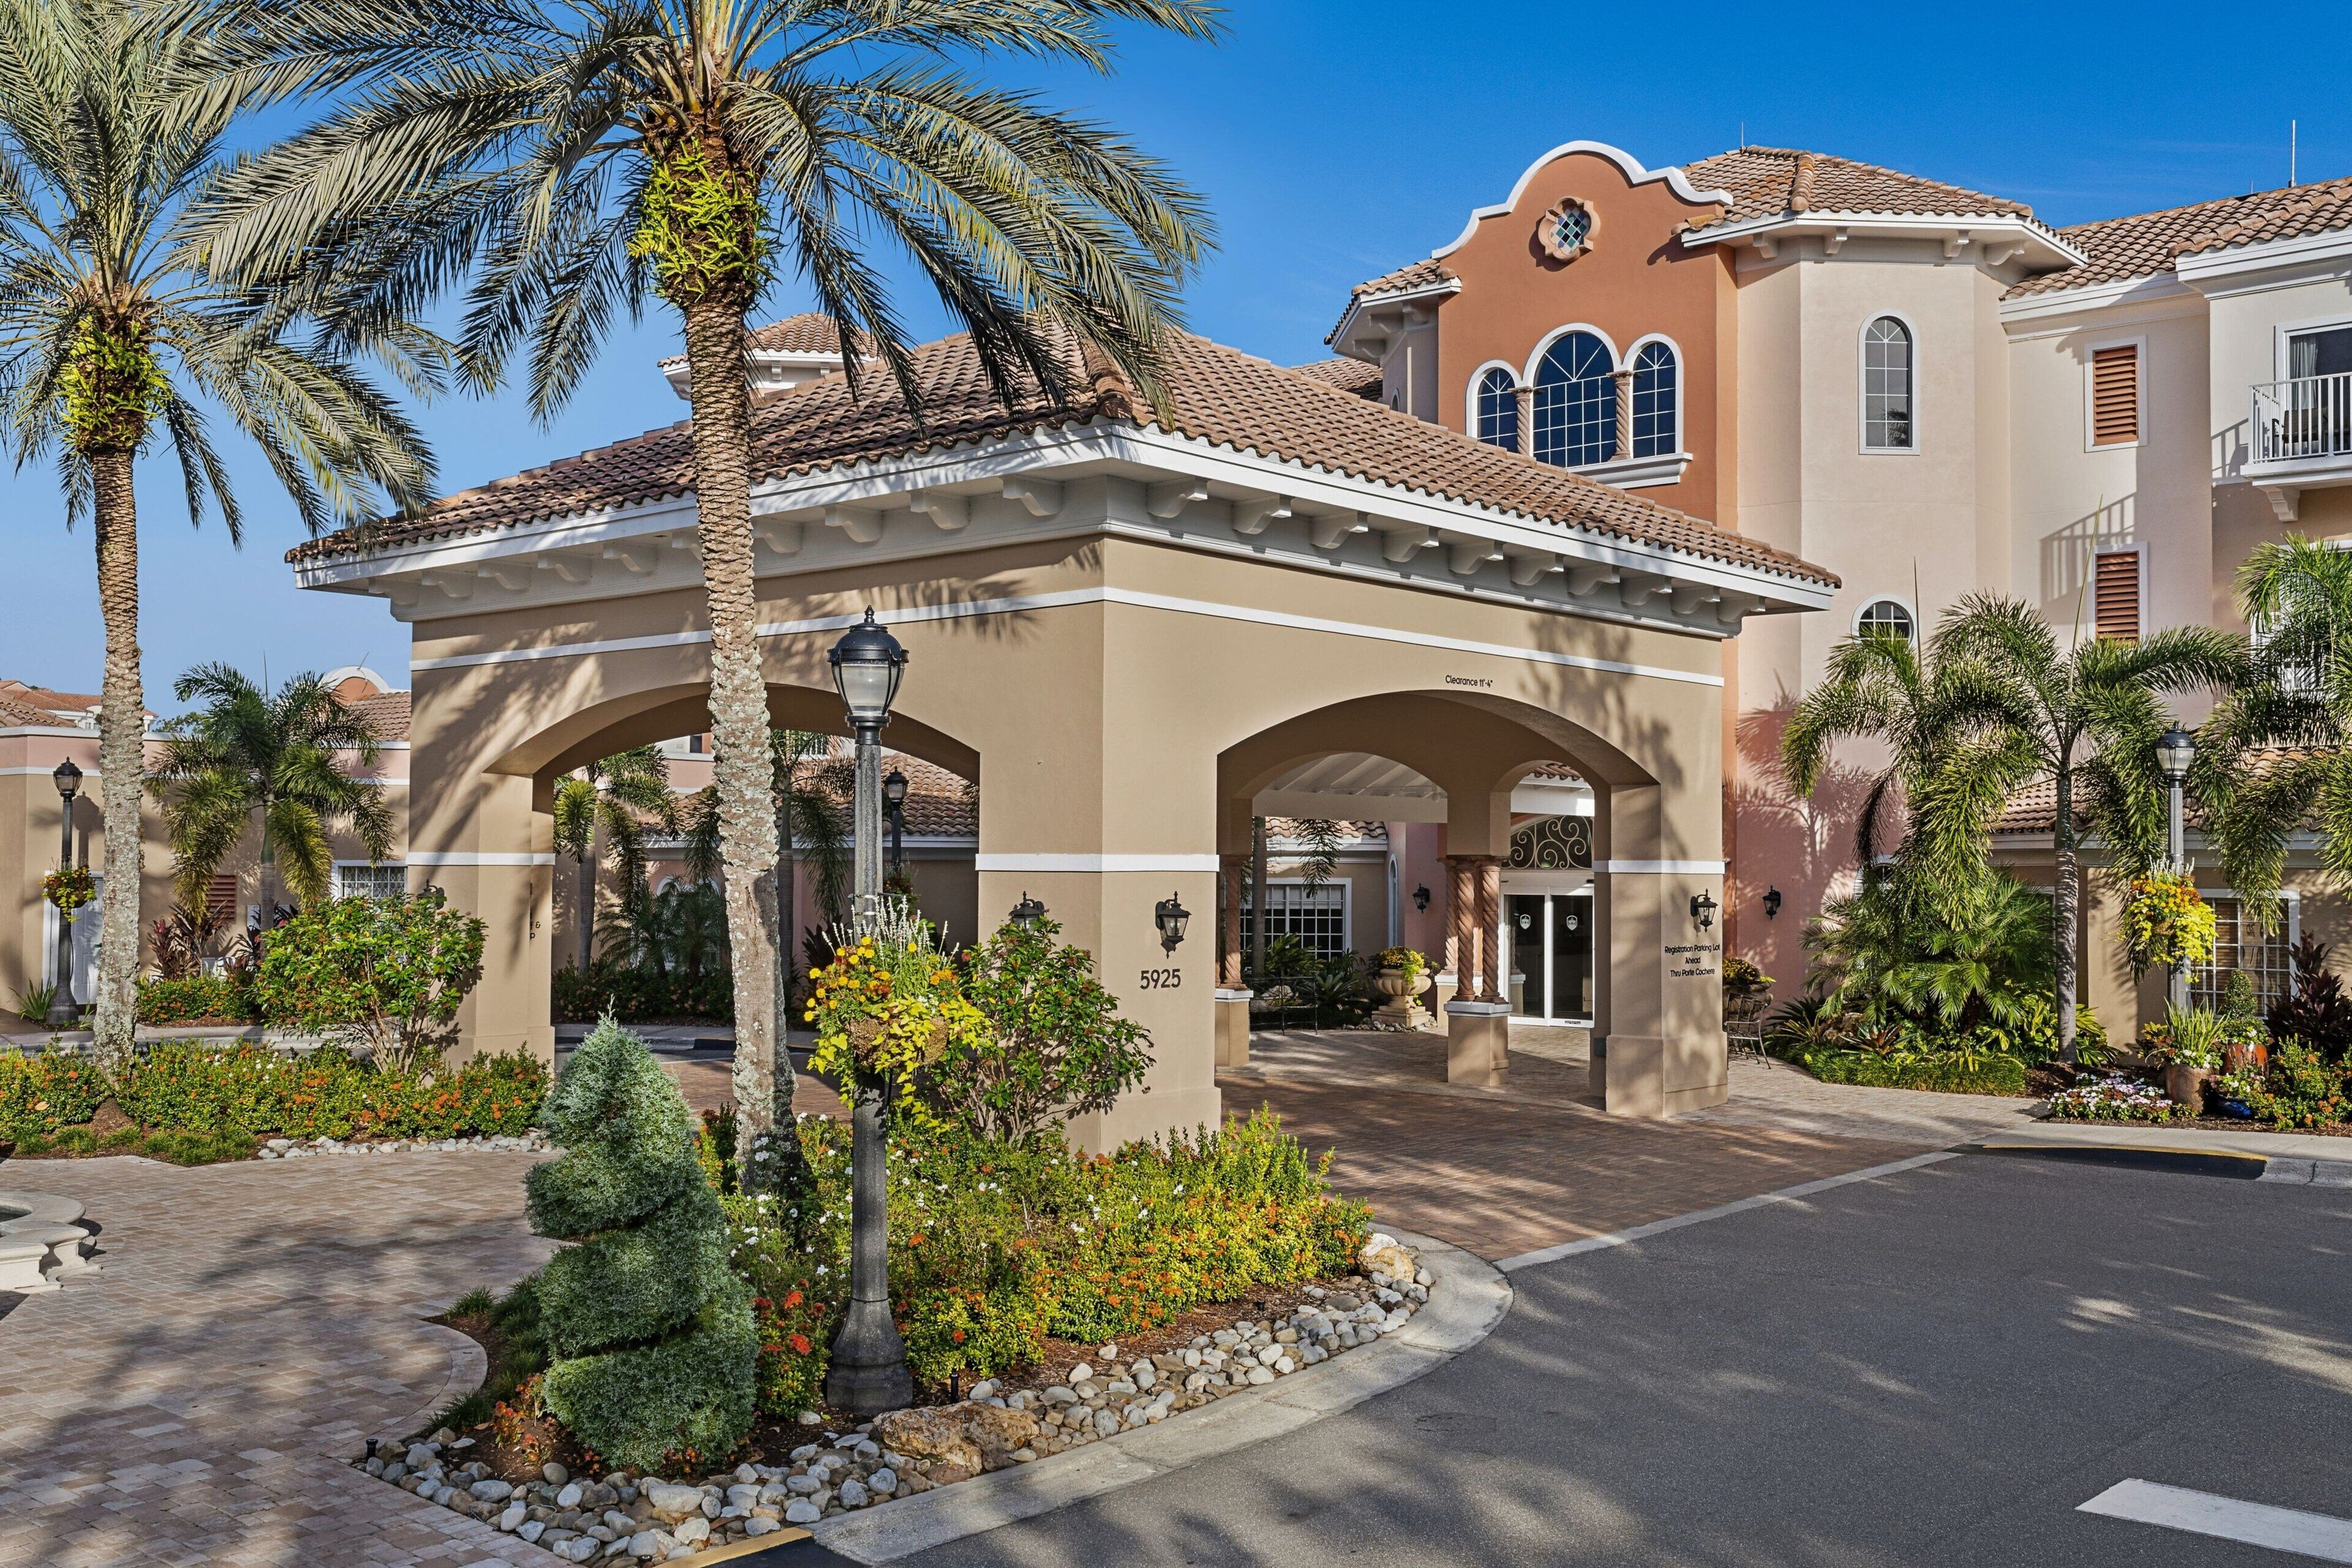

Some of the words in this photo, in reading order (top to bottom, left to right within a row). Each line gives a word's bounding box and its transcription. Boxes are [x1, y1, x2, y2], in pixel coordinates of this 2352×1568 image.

[1446, 675, 1478, 687] Clearance
[1665, 945, 1694, 956] Registration
[1694, 944, 1712, 953] Parking
[1685, 956, 1701, 965] Ahead
[1140, 968, 1182, 990] 5925
